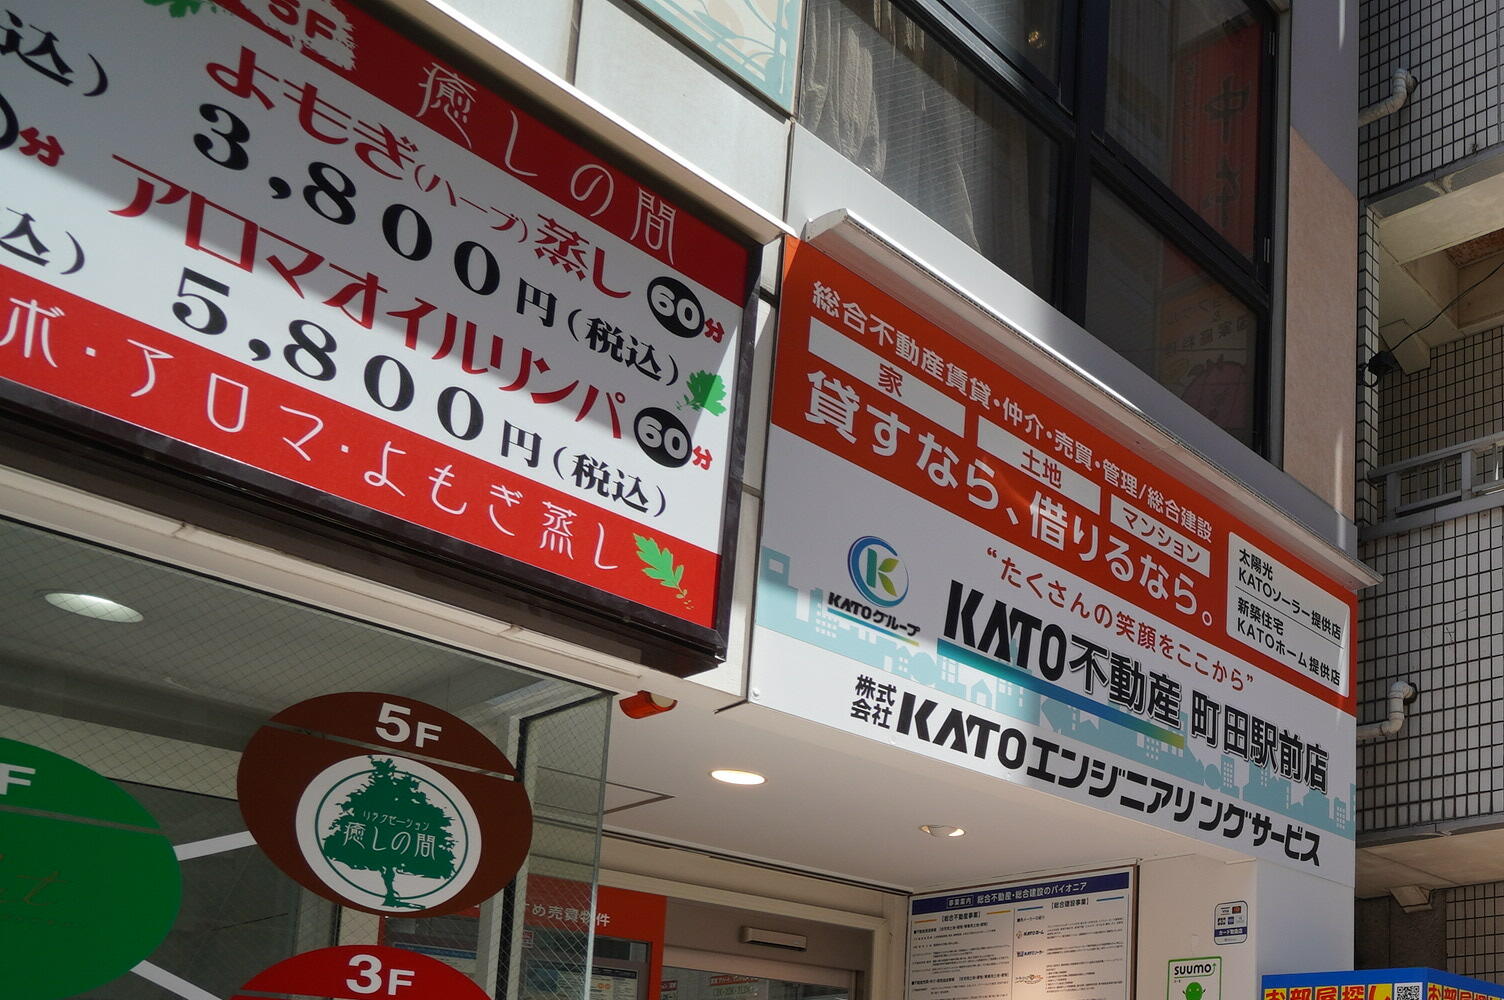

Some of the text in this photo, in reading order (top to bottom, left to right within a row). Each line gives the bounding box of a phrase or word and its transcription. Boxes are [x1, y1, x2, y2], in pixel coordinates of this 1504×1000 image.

[417, 62, 677, 266] 癒しの間
[108, 153, 626, 441] アロマオイルリンパ
[878, 364, 904, 397] 家
[1021, 449, 1062, 488] 土地
[804, 369, 1214, 628] 貸すなら、借りるなら。
[1122, 506, 1202, 564] マンション
[1238, 547, 1274, 582] 太陽光
[827, 591, 921, 638] KATOグループ
[1237, 596, 1285, 637] 新築住宅
[1238, 566, 1342, 641] KATOソーラー提供店
[1236, 616, 1342, 687] KATOホーム提供店
[943, 579, 1330, 794] KATO不動産 町田駅前店
[375, 702, 442, 749] 5F
[897, 691, 1321, 866] KATOエンジニアリングサービス
[343, 821, 437, 861] 癒しの間
[362, 809, 431, 831] リラクゼーション
[346, 954, 415, 996] 3F
